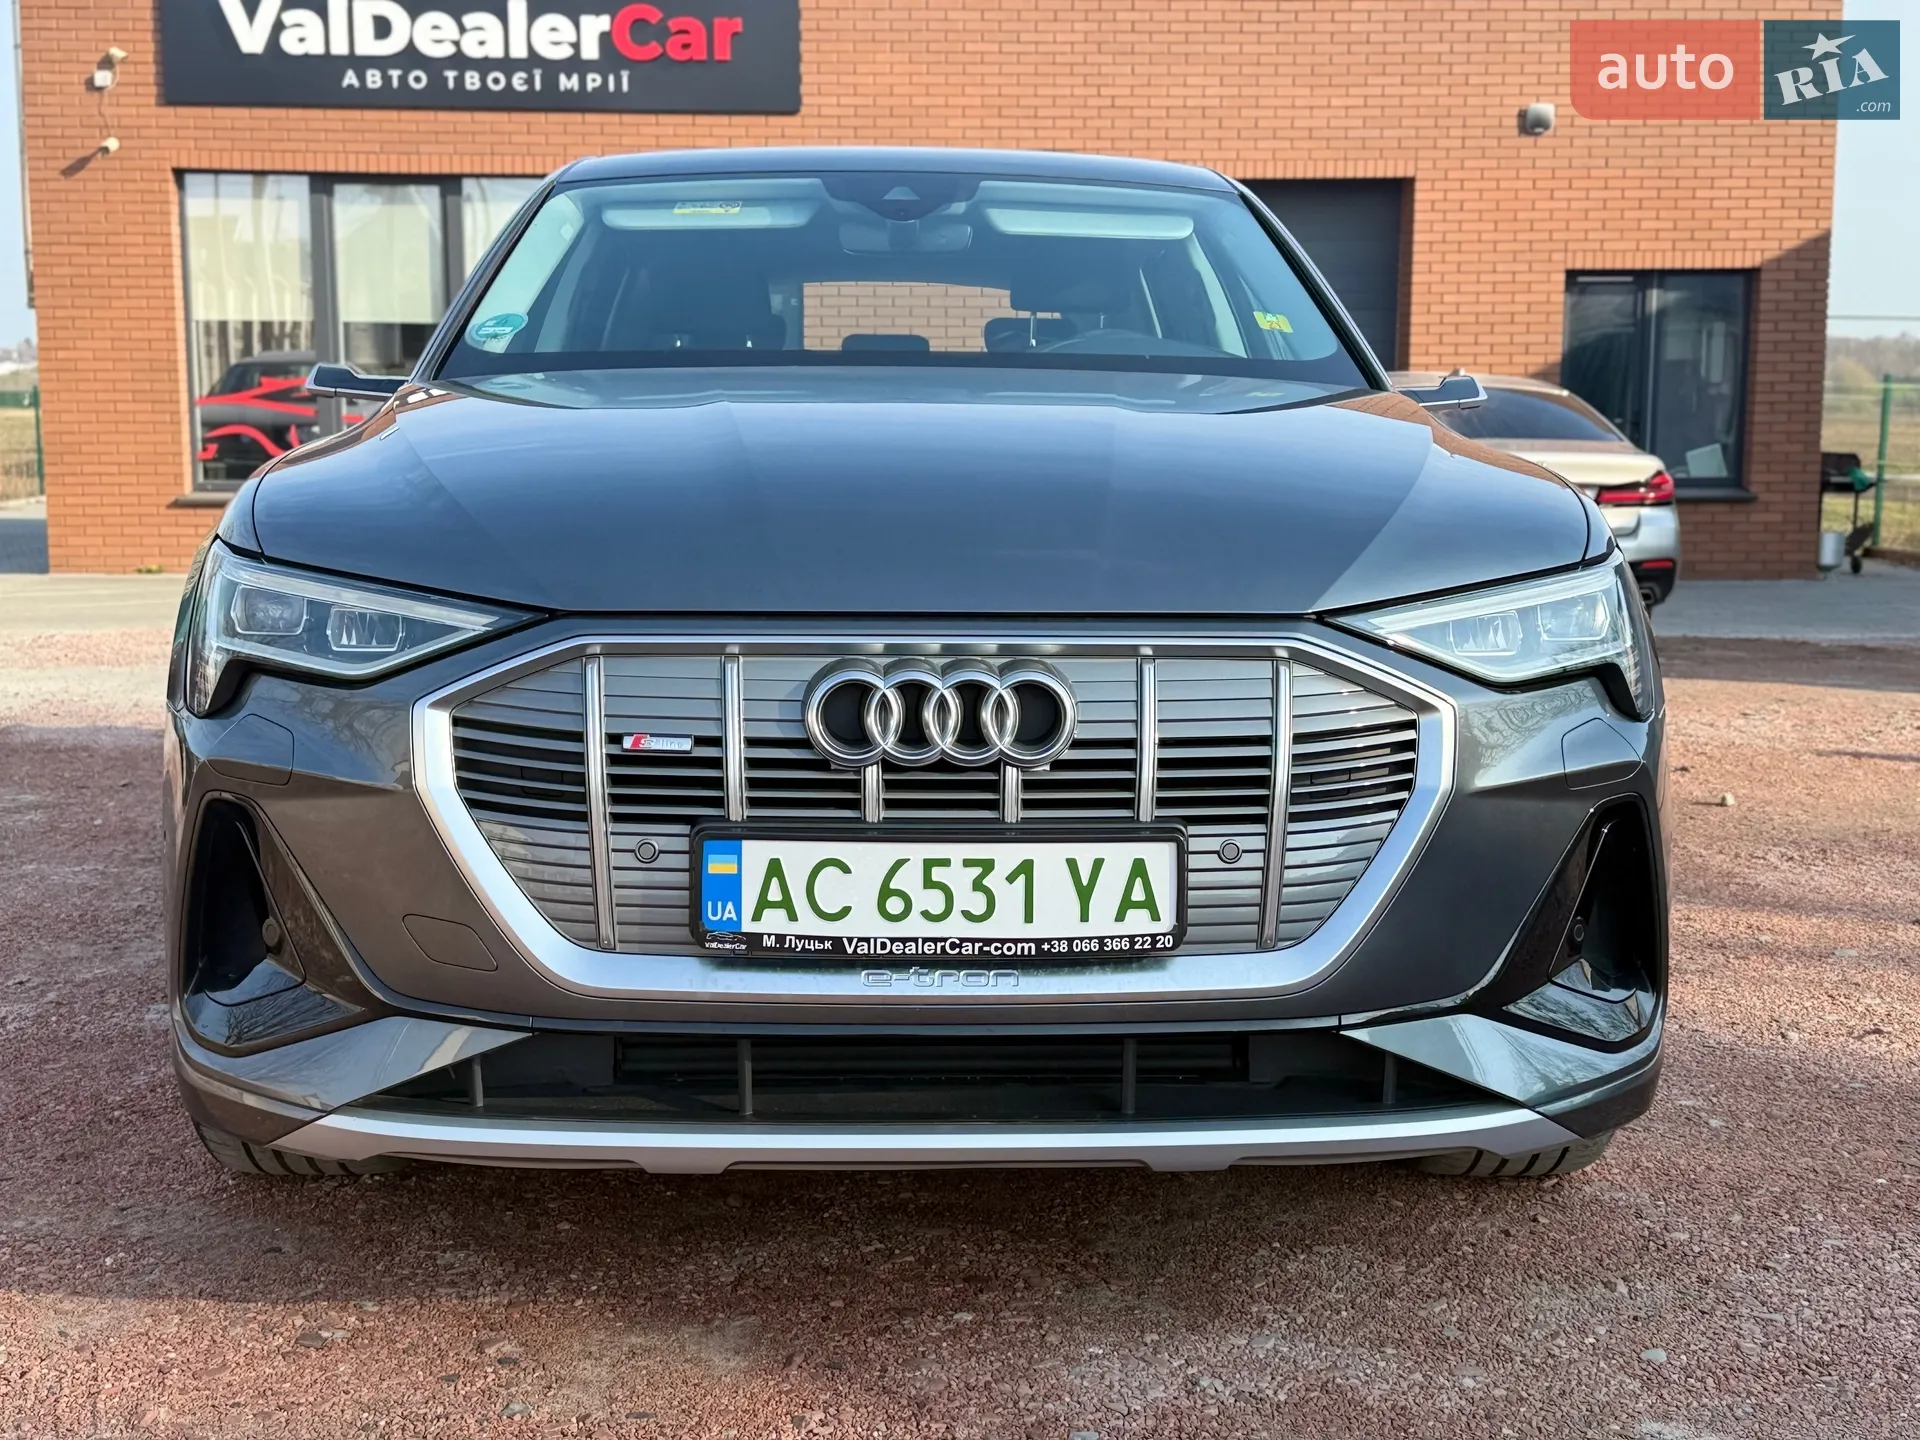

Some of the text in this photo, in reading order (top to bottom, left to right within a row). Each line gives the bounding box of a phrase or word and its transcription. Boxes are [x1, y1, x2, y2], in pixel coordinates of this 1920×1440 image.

[218, 0, 744, 62] ValDealerCar
[341, 68, 630, 93] АВТО ТВОЄЇ МРІЇ
[751, 857, 1162, 924] AC 6531 YA
[707, 901, 738, 922] UA
[762, 934, 833, 952] М. Луцьк
[842, 937, 1036, 956] ValDealerCar-com
[1041, 934, 1174, 953] +38 066 366 22 20
[861, 966, 1020, 988] e-tron
